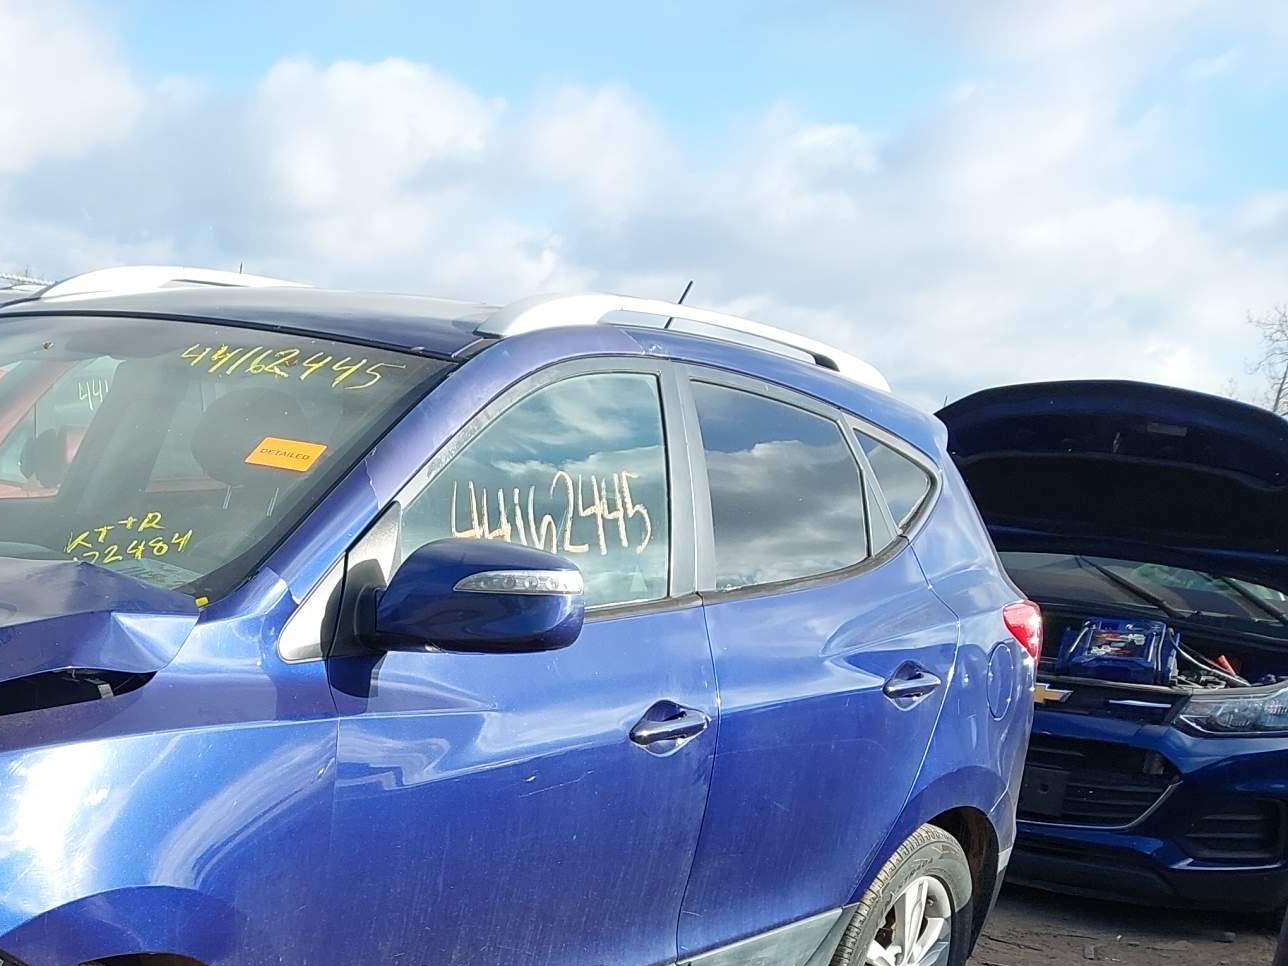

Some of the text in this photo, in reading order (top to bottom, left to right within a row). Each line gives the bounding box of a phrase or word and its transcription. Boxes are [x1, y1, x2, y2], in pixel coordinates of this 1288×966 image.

[180, 343, 407, 390] 44162445
[259, 447, 311, 461] DETAILED
[450, 470, 653, 556] 44162445
[73, 529, 193, 564] 72484
